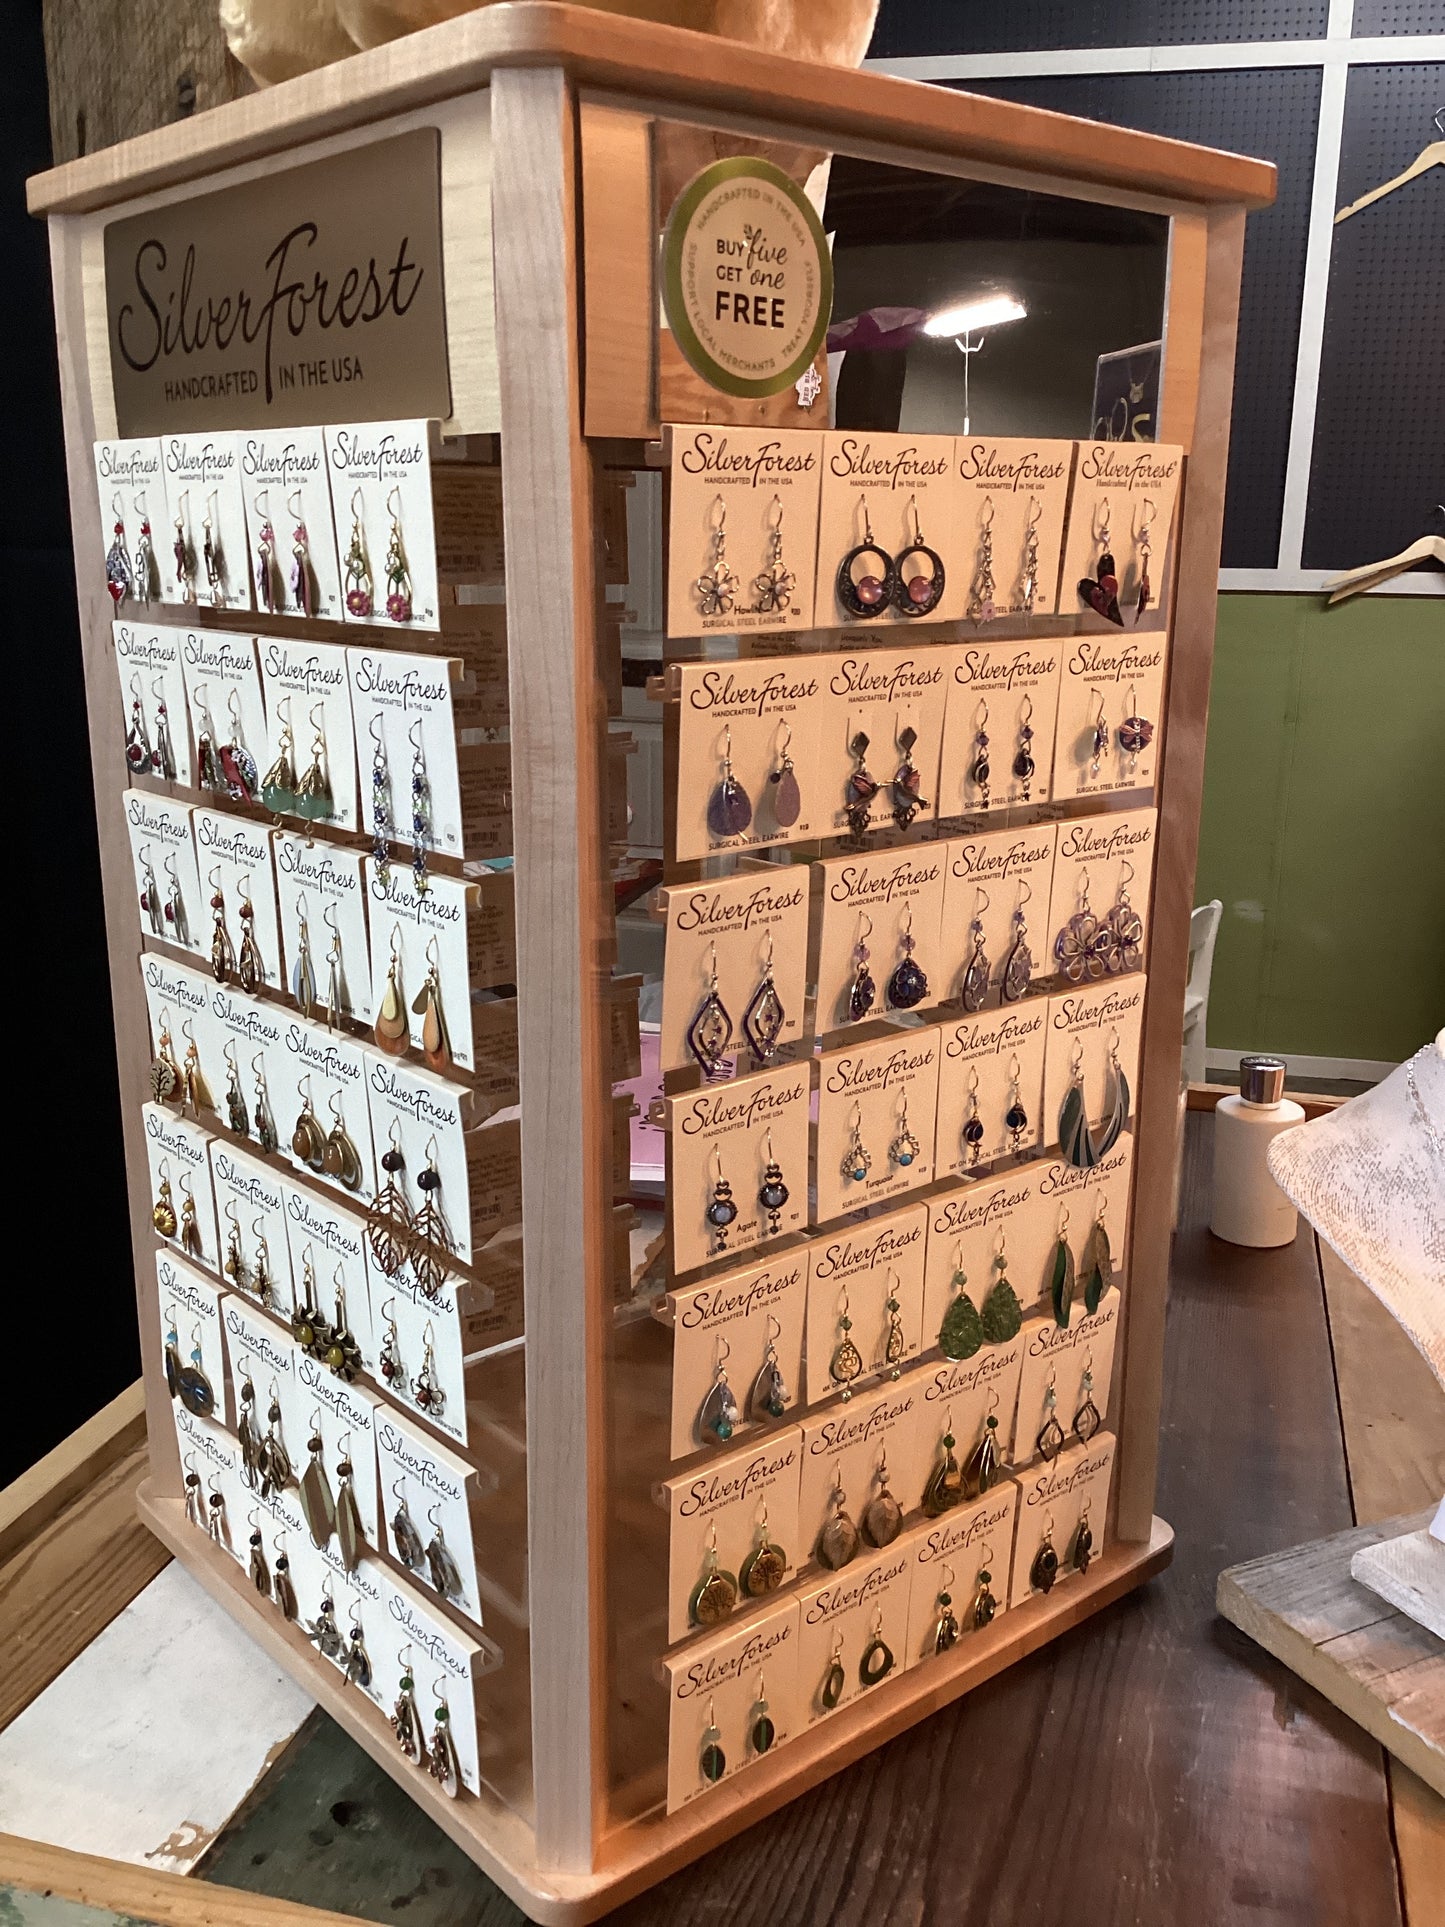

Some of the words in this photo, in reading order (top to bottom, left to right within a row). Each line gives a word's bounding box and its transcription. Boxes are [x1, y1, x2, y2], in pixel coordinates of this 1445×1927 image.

[698, 187, 761, 230] HANDCRAFTED
[762, 189, 773, 204] IN
[775, 199, 794, 223] THE
[791, 221, 806, 247] USA
[716, 239, 744, 257] BUY
[746, 228, 788, 269] five
[716, 265, 743, 282] GET
[750, 269, 785, 290] one
[685, 241, 698, 305] SUPPORT
[693, 313, 717, 351] LOCAL
[718, 350, 776, 372] MERCHANTS
[716, 290, 785, 329] FREE
[782, 327, 802, 360] TREAT
[165, 369, 258, 402] HANDCRAFTED
[279, 365, 295, 389] IN
[299, 361, 328, 385] THE
[332, 356, 363, 382] USA
[704, 477, 750, 485] HANDCRAFTED
[702, 619, 736, 629] SURGICAL
[737, 618, 753, 627] STEEL
[848, 694, 887, 703] HANDCRAFTED
[712, 707, 756, 718] HANDCRAFTED
[765, 706, 771, 714] IN
[773, 705, 784, 713] THE
[1076, 785, 1098, 794] SURGICAL
[709, 838, 740, 850] SURGICAL
[762, 832, 789, 842] EARWIRE
[848, 895, 885, 908] HANDCRAFTED
[698, 922, 742, 936] HANDCRAFTED
[758, 917, 770, 925] THE
[771, 915, 782, 923] USA
[703, 1121, 745, 1139] HANDCRAFTED
